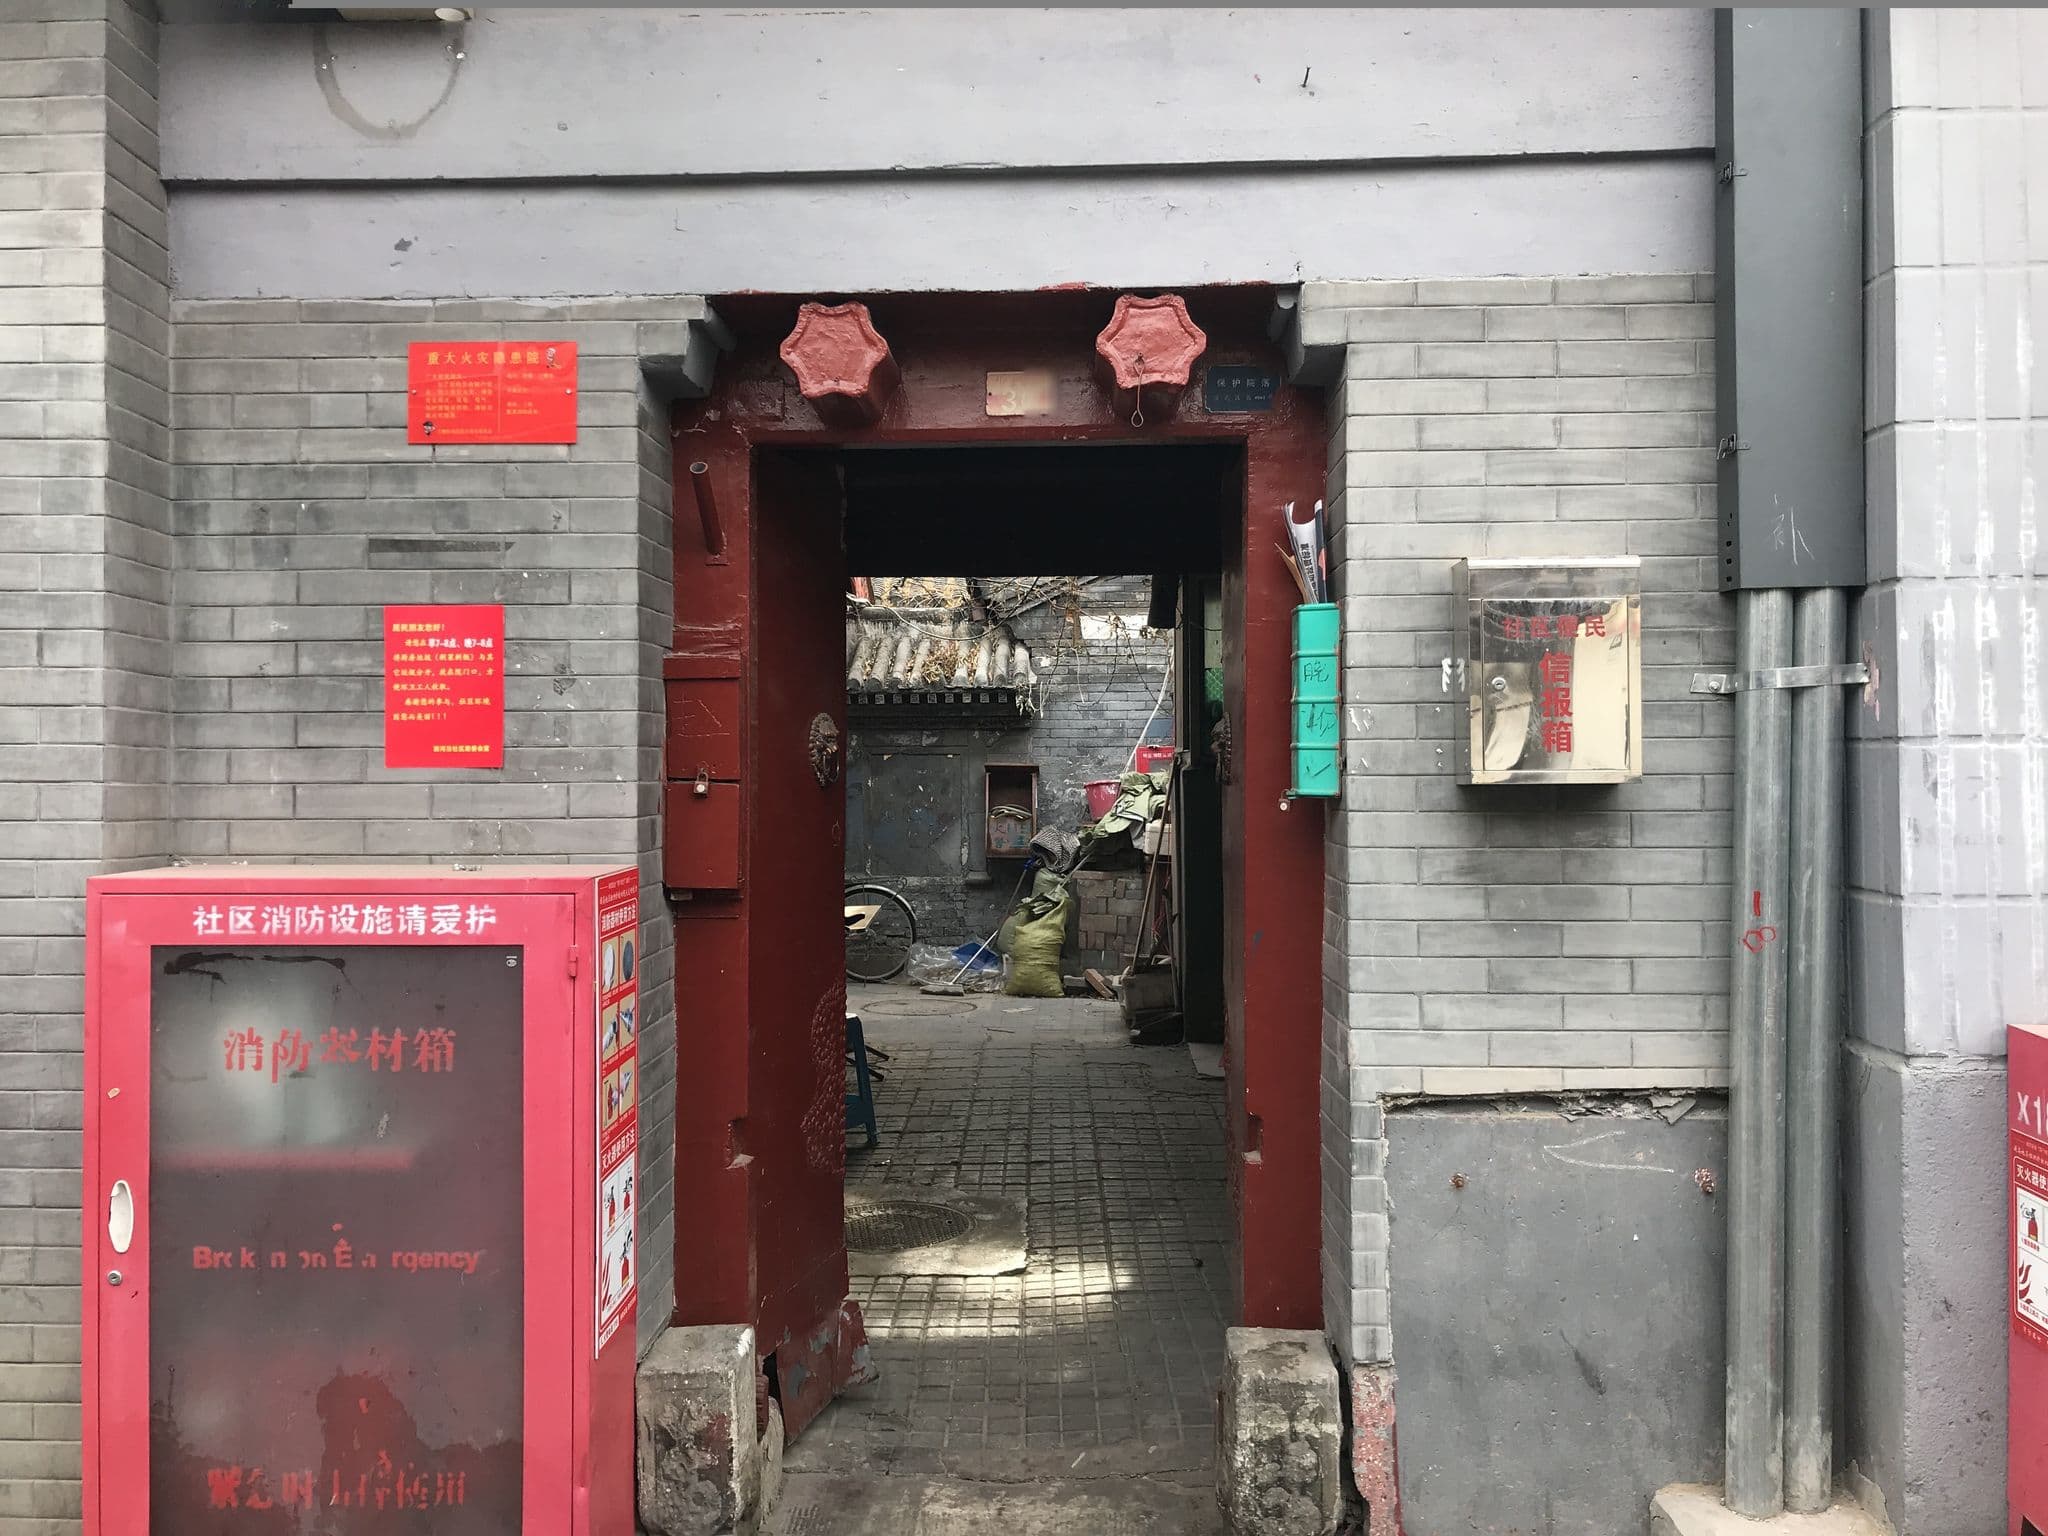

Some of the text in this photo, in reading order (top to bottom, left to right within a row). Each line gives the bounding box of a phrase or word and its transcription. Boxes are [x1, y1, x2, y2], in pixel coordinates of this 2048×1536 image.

[1502, 615, 1606, 638] 社区便民
[1538, 651, 1574, 753] 信报箱
[192, 904, 497, 936] 社区消防设施请爱护
[192, 1246, 288, 1269] Brkn
